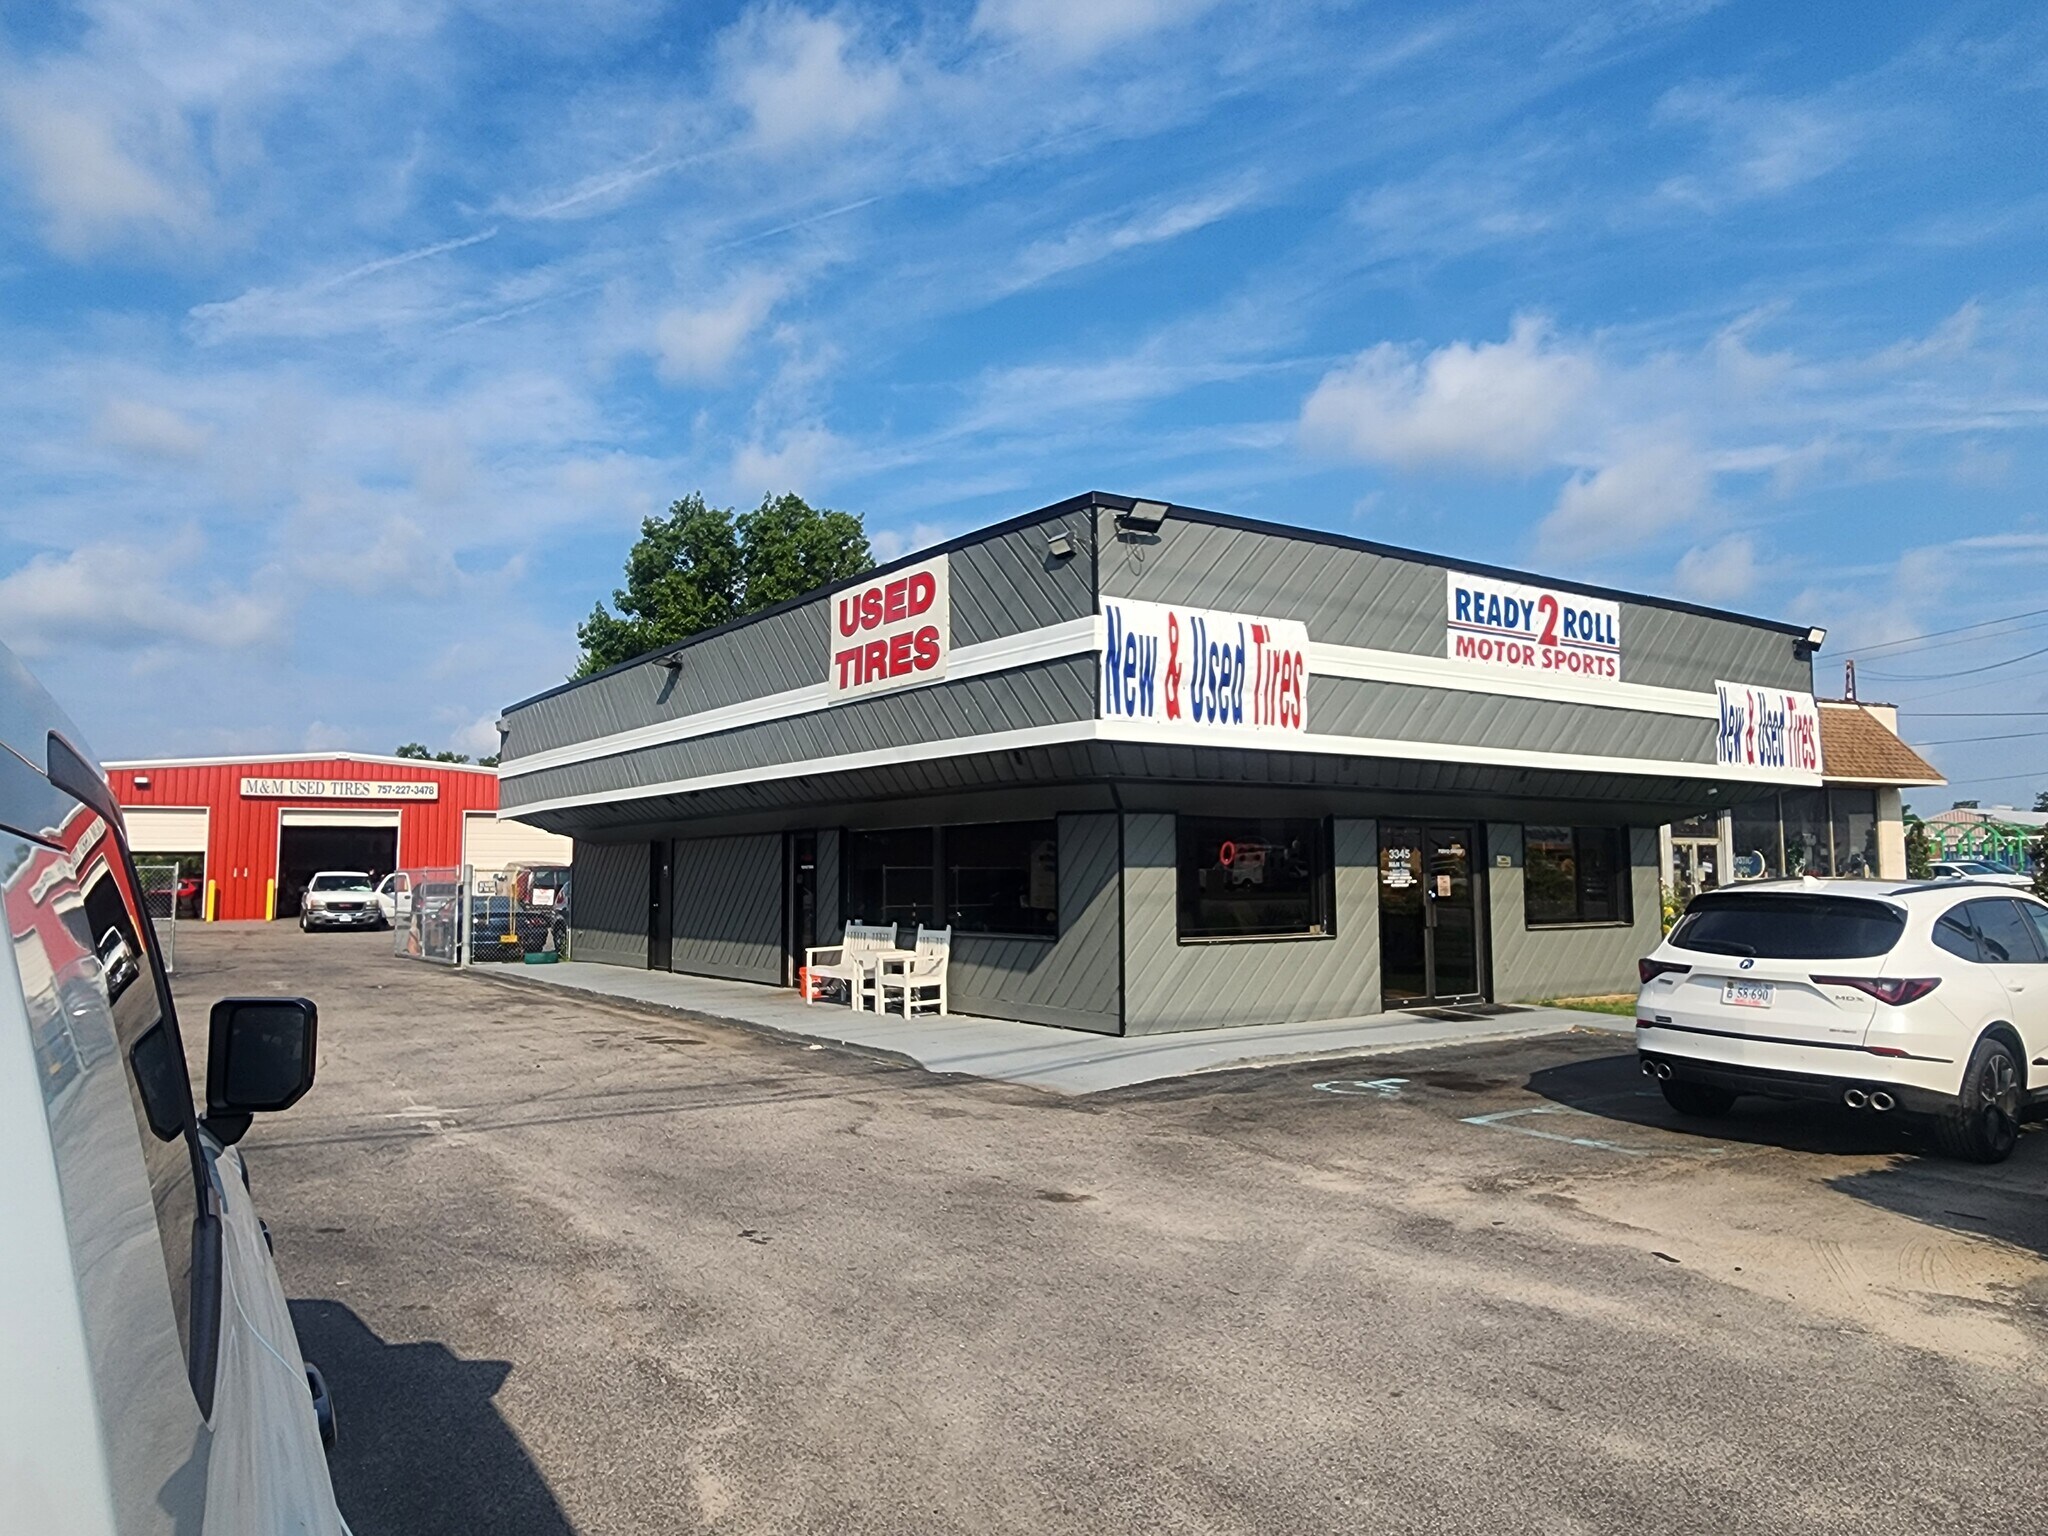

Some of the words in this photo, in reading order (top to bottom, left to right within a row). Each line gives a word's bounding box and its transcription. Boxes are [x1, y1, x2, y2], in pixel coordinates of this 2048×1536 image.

[839, 571, 936, 637] USED
[1455, 587, 1535, 631] READY
[1537, 594, 1558, 647] 2
[1563, 607, 1616, 644] ROLL
[835, 625, 940, 690] TIRES
[1105, 605, 1158, 718] New
[1165, 611, 1183, 721] &
[1190, 616, 1246, 725] Used
[1250, 623, 1304, 730] Tires
[1456, 635, 1535, 667] MOTOR
[1541, 648, 1616, 677] SPORTS
[1718, 686, 1745, 763] New
[1745, 689, 1755, 765] &
[1757, 692, 1785, 767] Used
[1786, 696, 1816, 770] Tires
[245, 779, 284, 795] M&M
[289, 781, 325, 795] USED
[331, 782, 370, 796] TIRES
[377, 785, 434, 795] 757-227-3478
[1388, 849, 1411, 860] 3345
